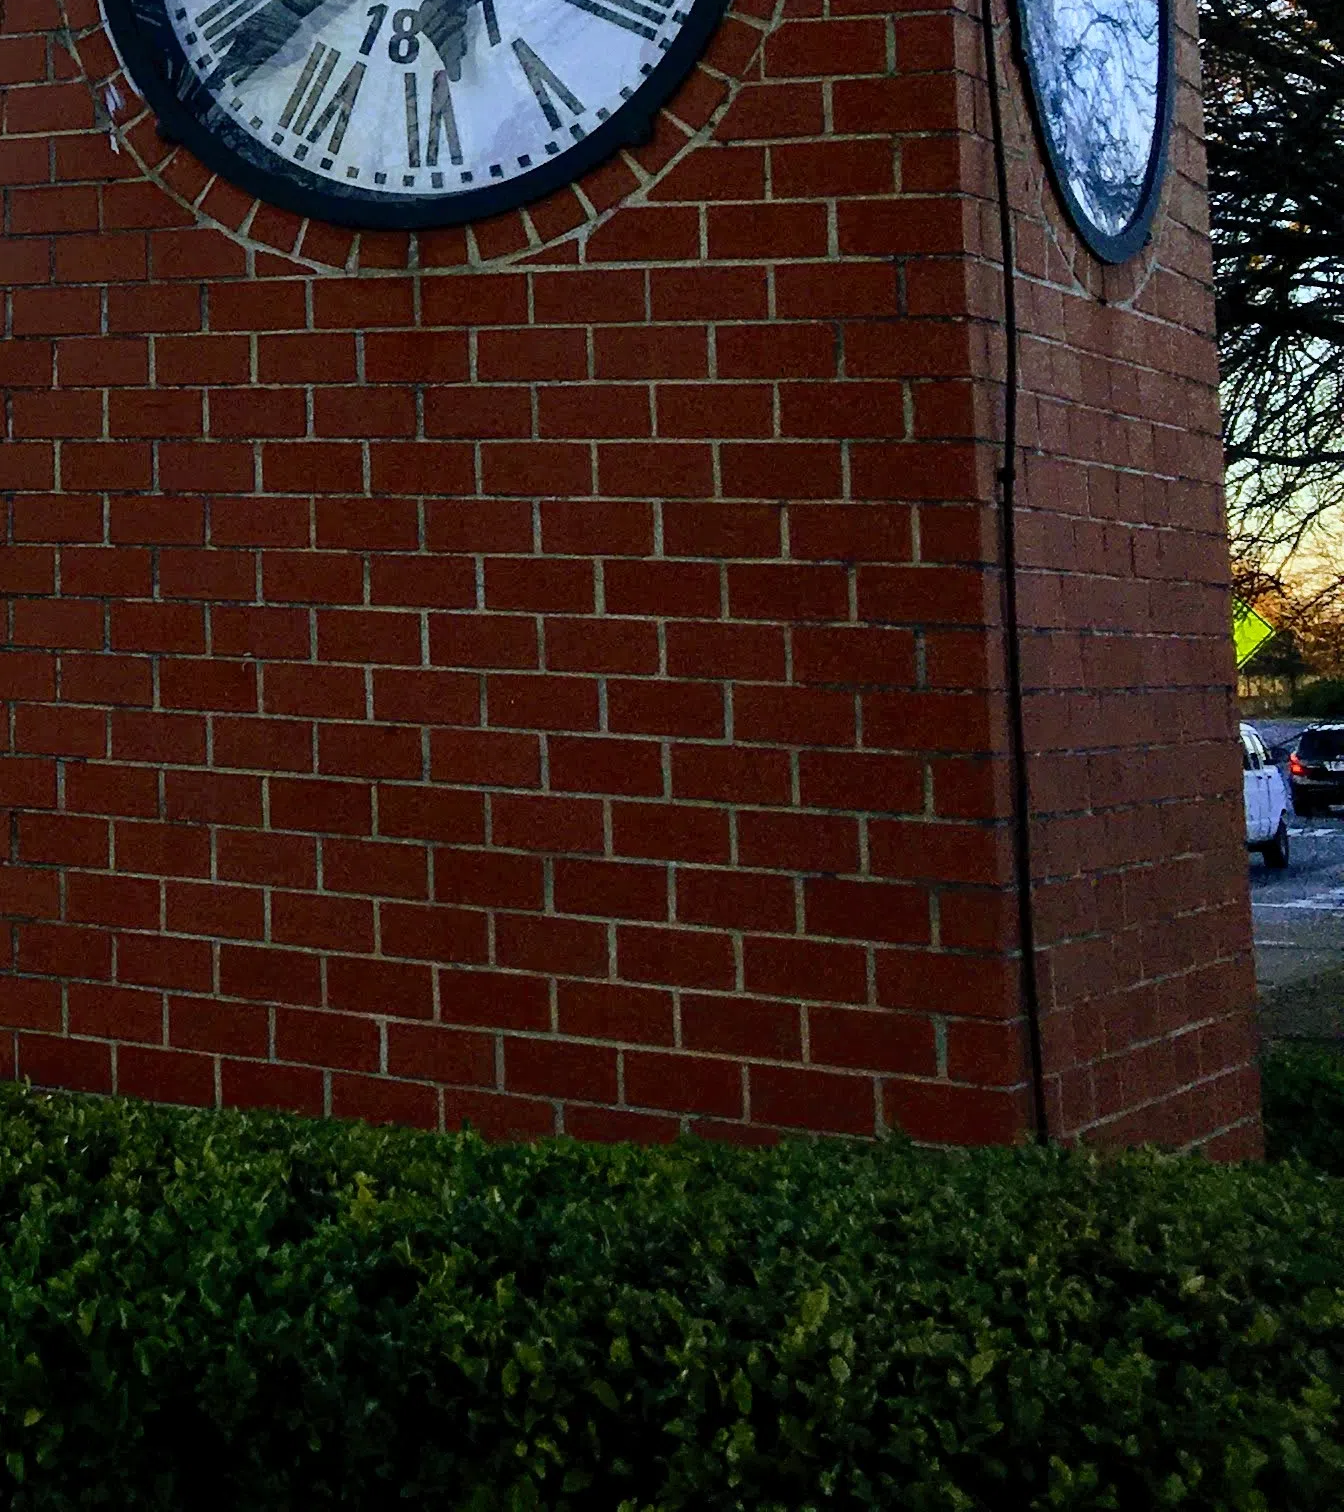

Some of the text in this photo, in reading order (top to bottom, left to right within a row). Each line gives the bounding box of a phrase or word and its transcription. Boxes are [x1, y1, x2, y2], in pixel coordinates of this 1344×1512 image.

[277, 41, 368, 156] VII
[404, 69, 463, 169] VI
[511, 37, 586, 131] V
